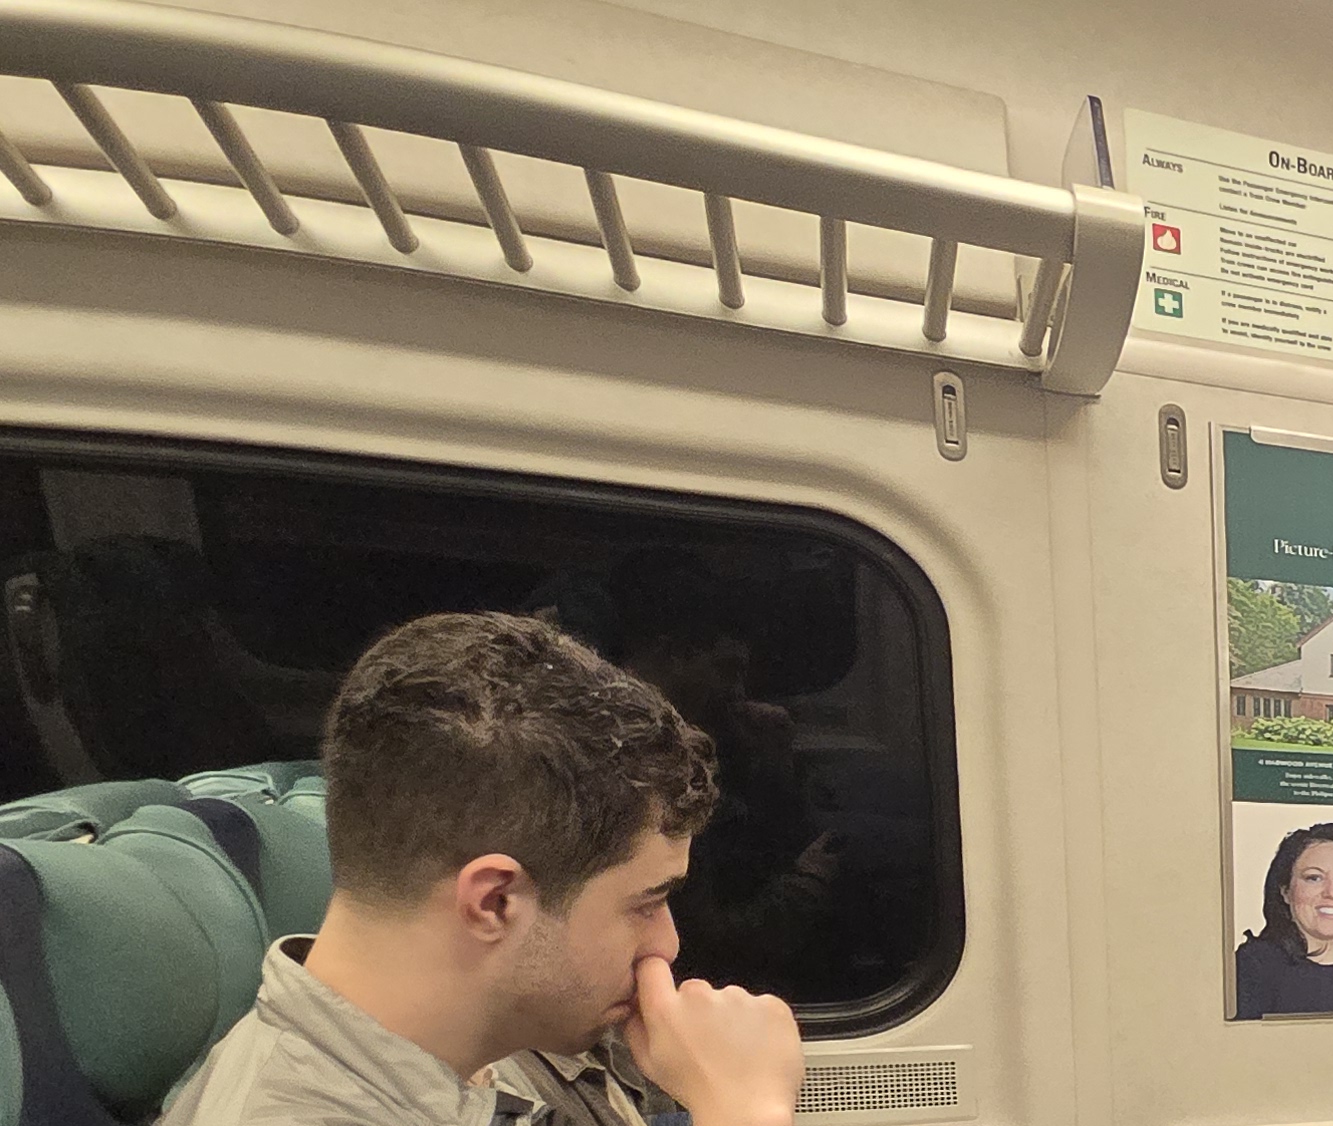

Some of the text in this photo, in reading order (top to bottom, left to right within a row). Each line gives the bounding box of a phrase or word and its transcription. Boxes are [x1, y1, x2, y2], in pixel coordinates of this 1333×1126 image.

[1142, 154, 1183, 173] ALWAYS
[1144, 206, 1166, 221] FIRE
[1145, 272, 1190, 291] MEDICAL
